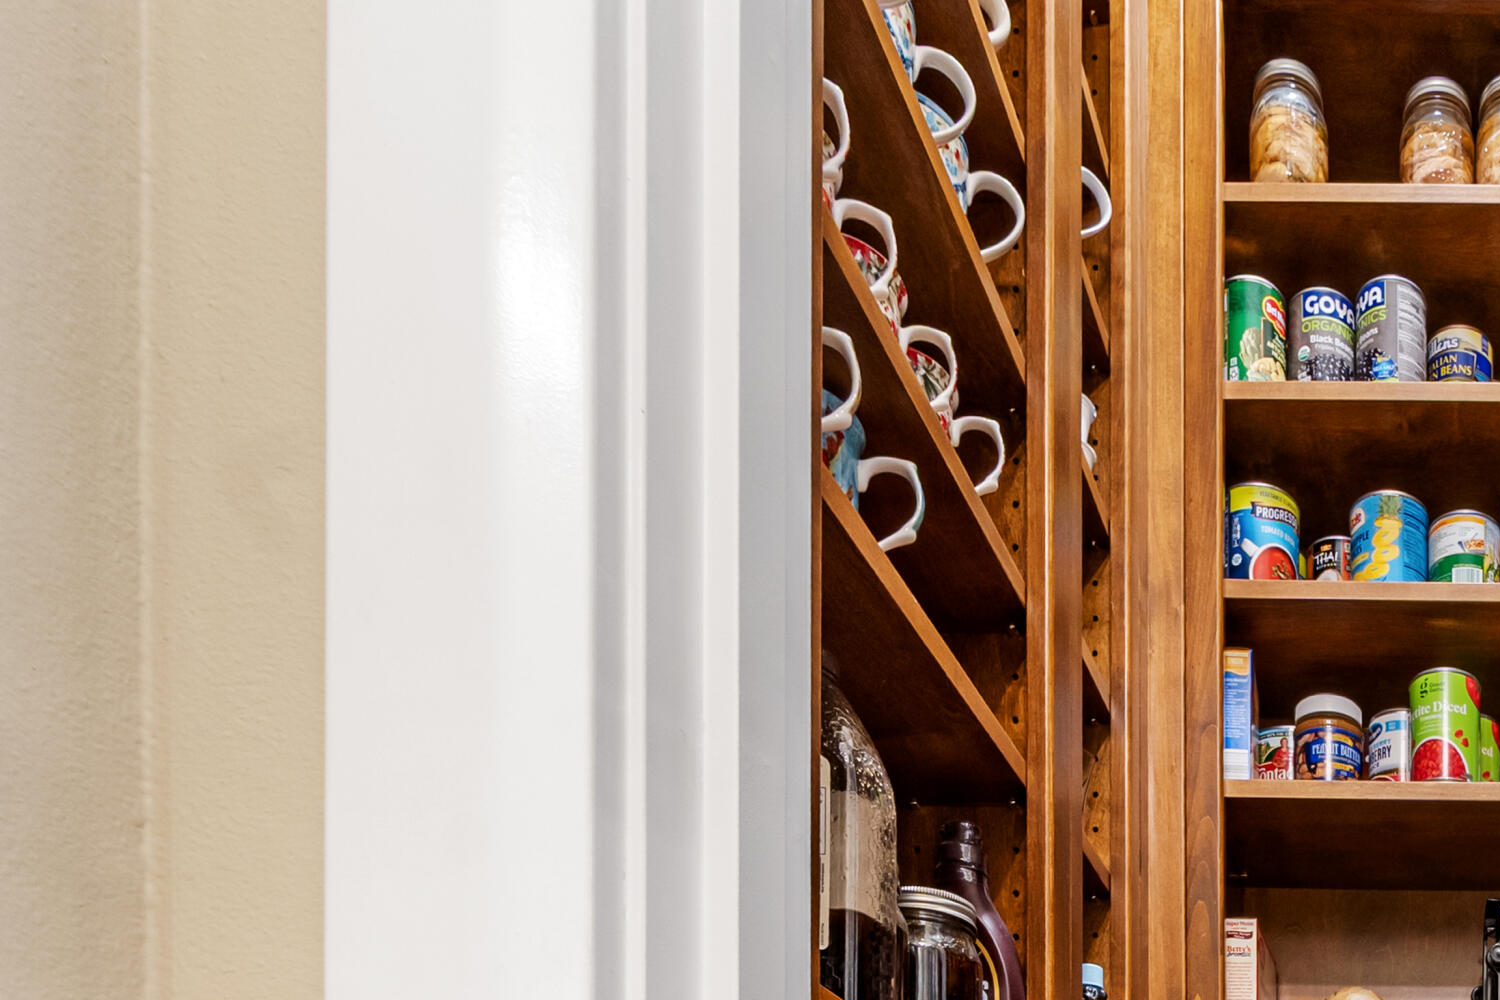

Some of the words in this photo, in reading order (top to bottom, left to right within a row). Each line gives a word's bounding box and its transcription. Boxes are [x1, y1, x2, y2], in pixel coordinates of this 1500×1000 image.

[1304, 295, 1355, 331] GOYA
[1441, 363, 1472, 377] BEANS
[1314, 551, 1339, 565] THAI
